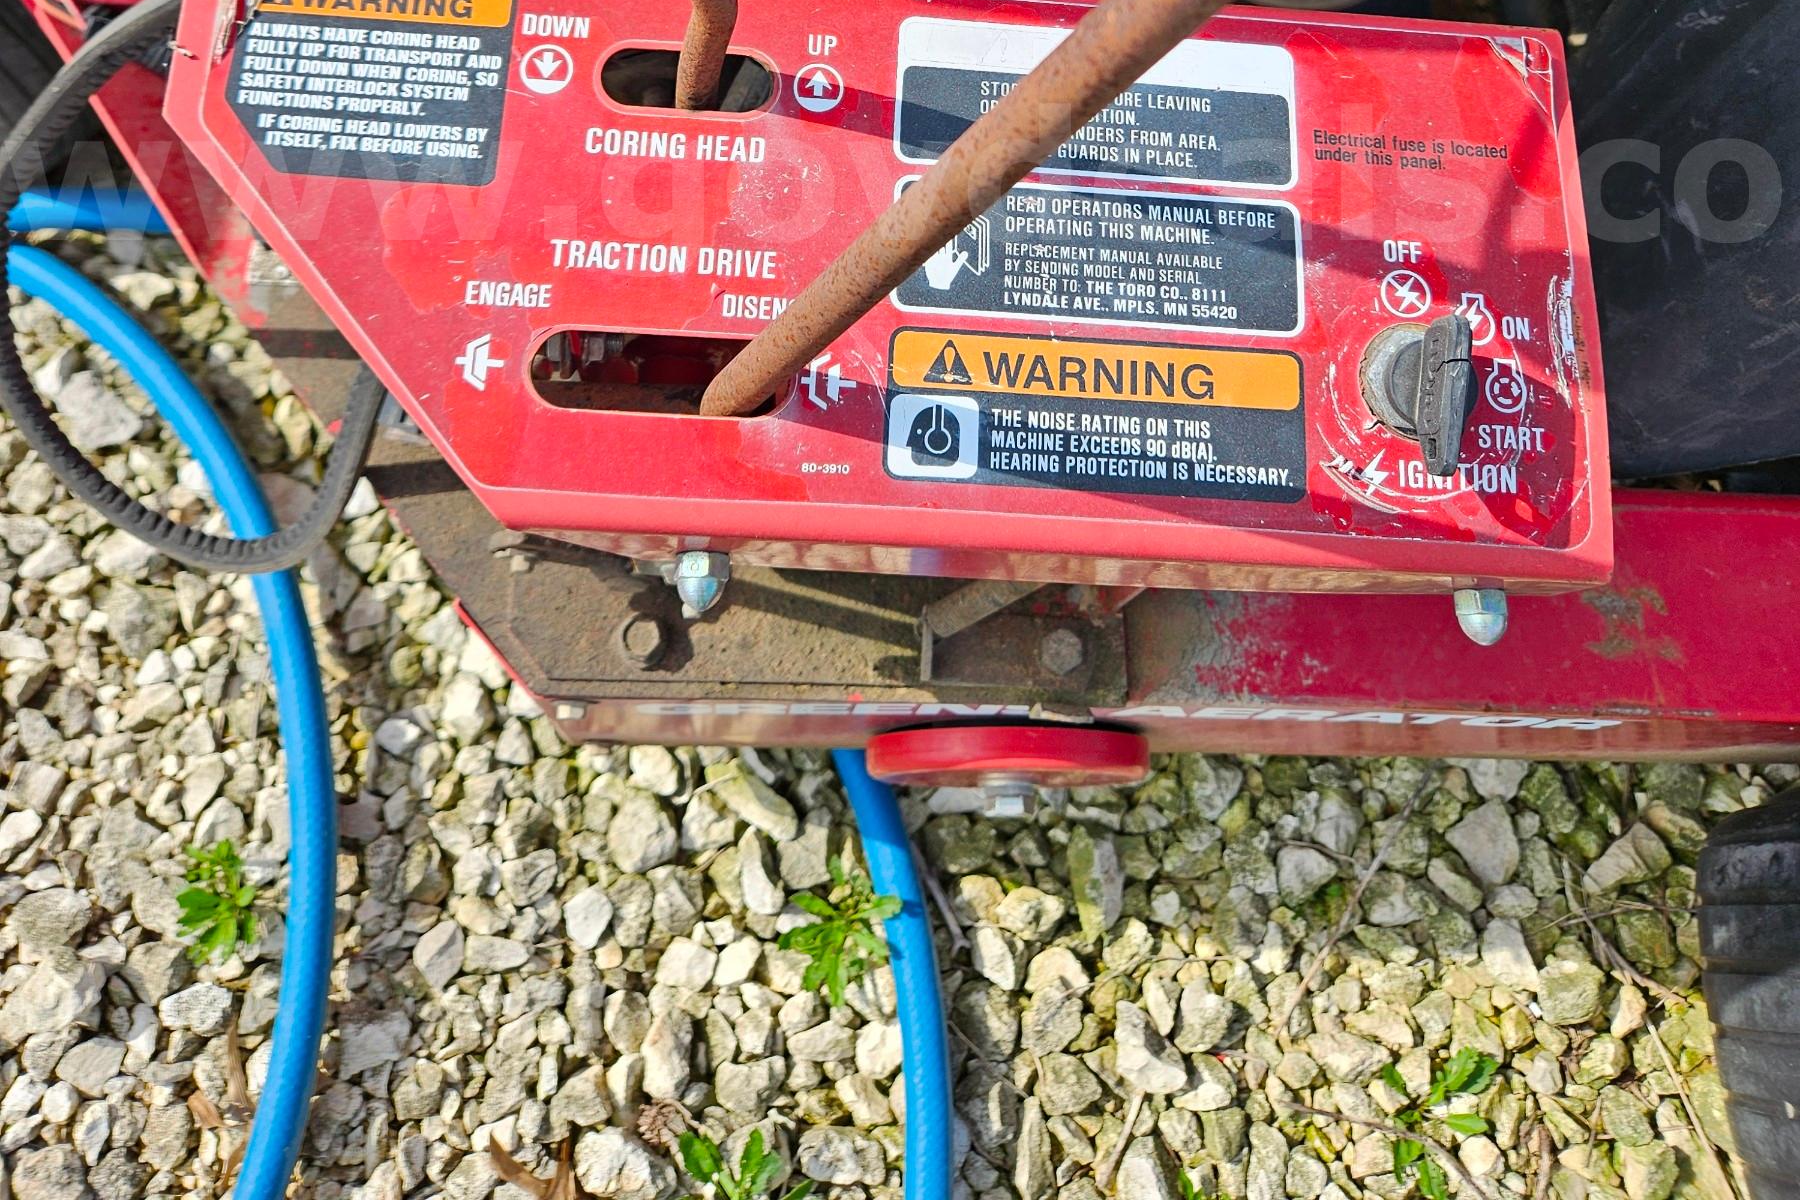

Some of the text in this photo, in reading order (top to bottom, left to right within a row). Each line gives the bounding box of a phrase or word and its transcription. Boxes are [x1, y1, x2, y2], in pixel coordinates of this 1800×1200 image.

[250, 22, 480, 51] ALWAYS HAVE CORING HEAD
[521, 13, 590, 39] DOWN
[247, 39, 502, 70] FULLY UP FOR TRANSPORT AND
[807, 33, 837, 56] UP
[243, 56, 499, 87] FULLY DOWN WHEN CORING, SO
[240, 73, 469, 101] SAFETY INTERLOCK SYSTEM
[238, 90, 426, 116] FUNCTIONS PROPERLY.
[1148, 94, 1211, 113] LEAVING
[257, 113, 488, 143] IF CORING HEAD LOWERS BY
[1131, 129, 1172, 147] FROM
[1179, 134, 1221, 151] AREA.
[264, 130, 483, 158] ITSELF, FIX BEFORE USING.
[585, 127, 766, 163] CORING HEAD
[1058, 144, 1198, 168] GUARDS IN PLACE.
[1313, 129, 1508, 159] Electrical fuse is located
[1315, 148, 1446, 170] under this panel.
[1006, 196, 1275, 229] READ OPERATORS MANUAL BEFORE
[1005, 217, 1215, 245] OPERATING THIS MACHINE.
[550, 238, 777, 280] TRACTION DRIVE
[1005, 242, 1223, 269] REPLACEMENT MANUAL AVAILABLE
[1383, 239, 1422, 264] OFF
[1004, 259, 1202, 285] BY SENDING MODEL AND SERIAL
[465, 280, 552, 308] ENGAGE
[1004, 275, 1057, 293] NUMBER
[1061, 279, 1081, 293] TO:
[1086, 280, 1114, 295] THE
[1117, 283, 1157, 298] TORO
[1191, 288, 1226, 302] 8111
[722, 294, 797, 320] DISEN
[1003, 292, 1069, 308] LYNDALE
[1164, 303, 1188, 316] MN
[1191, 305, 1237, 320] 55420
[1501, 316, 1530, 341] ON
[983, 351, 1215, 400] WARNING
[991, 409, 1211, 439] THE NOISE RATING ON THIS
[991, 431, 1217, 463] MACHINE EXCEEDS 90 dB(A).
[1478, 424, 1545, 453] START
[801, 462, 849, 475] 80-3910
[990, 452, 1294, 487] HEARING PROTECTION IS NECESSARY.
[1398, 459, 1517, 494] IGNITION
[1109, 704, 1623, 731] AERATOR
